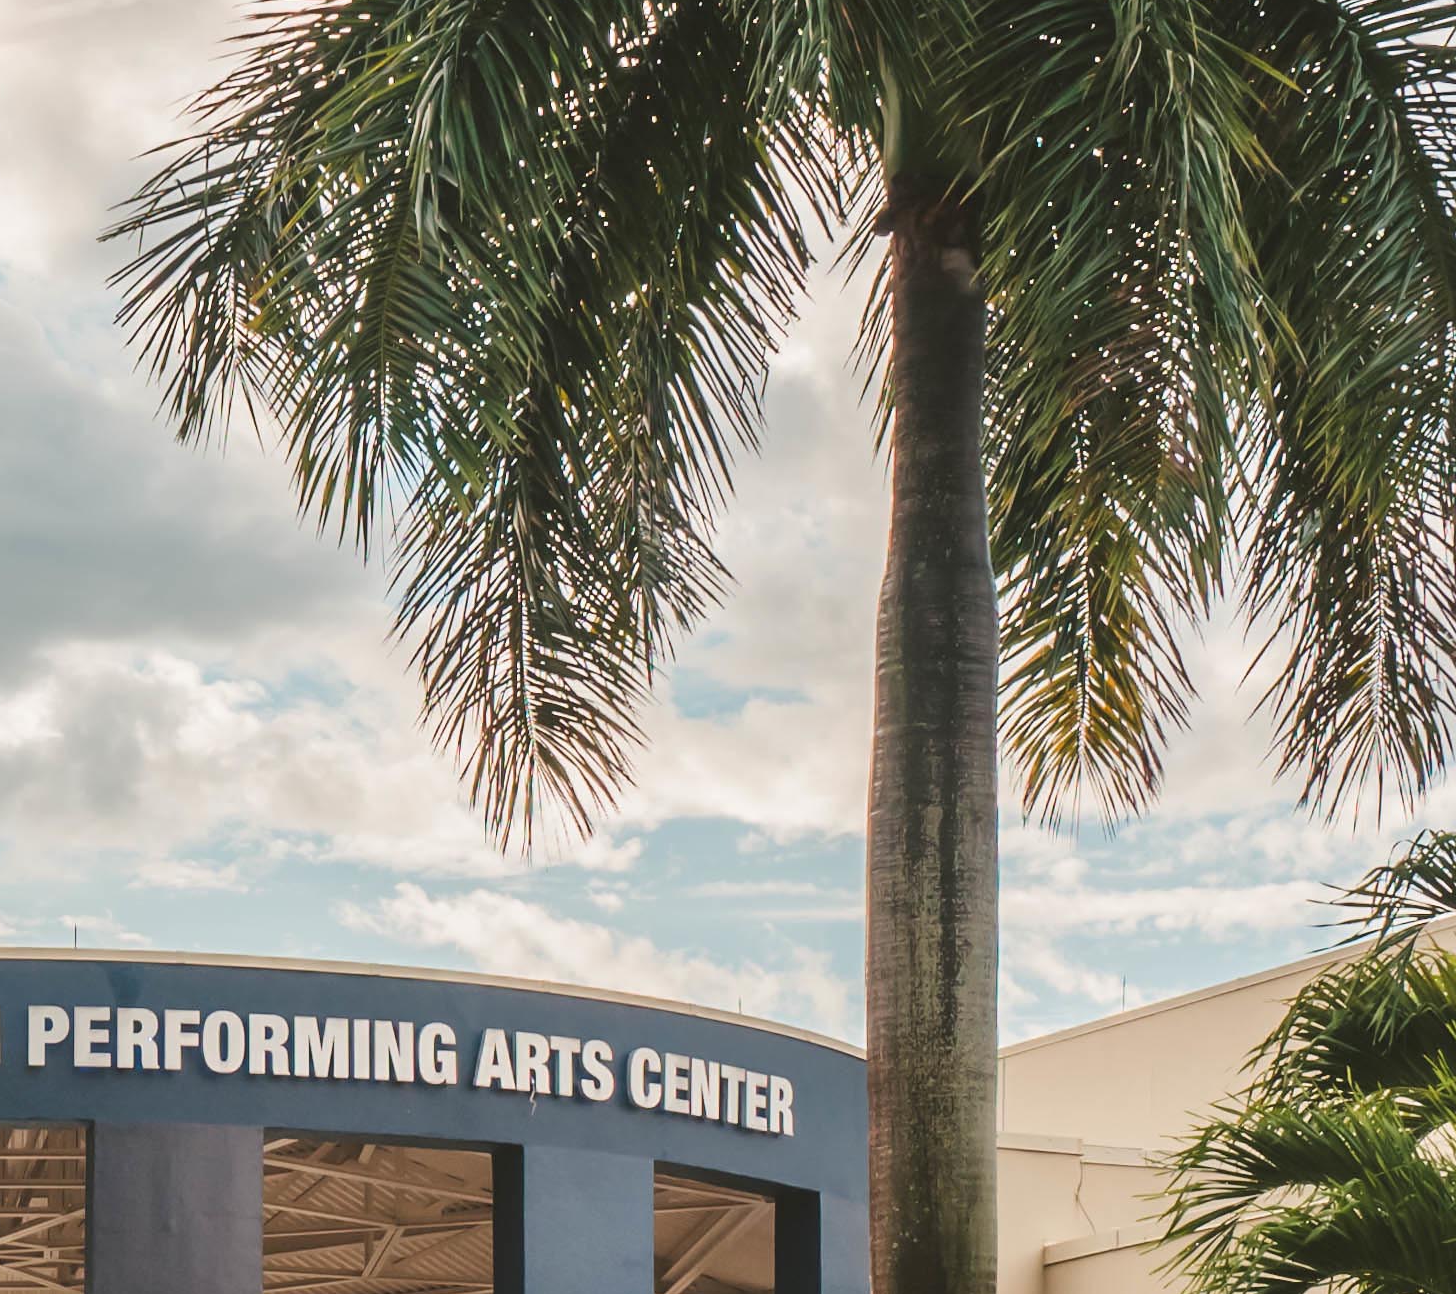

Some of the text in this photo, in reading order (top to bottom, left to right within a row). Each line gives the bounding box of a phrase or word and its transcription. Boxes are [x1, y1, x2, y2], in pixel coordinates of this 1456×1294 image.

[27, 1004, 458, 1086] PERFORMING
[473, 1027, 616, 1102] ARTS
[626, 1047, 796, 1137] CENTER
